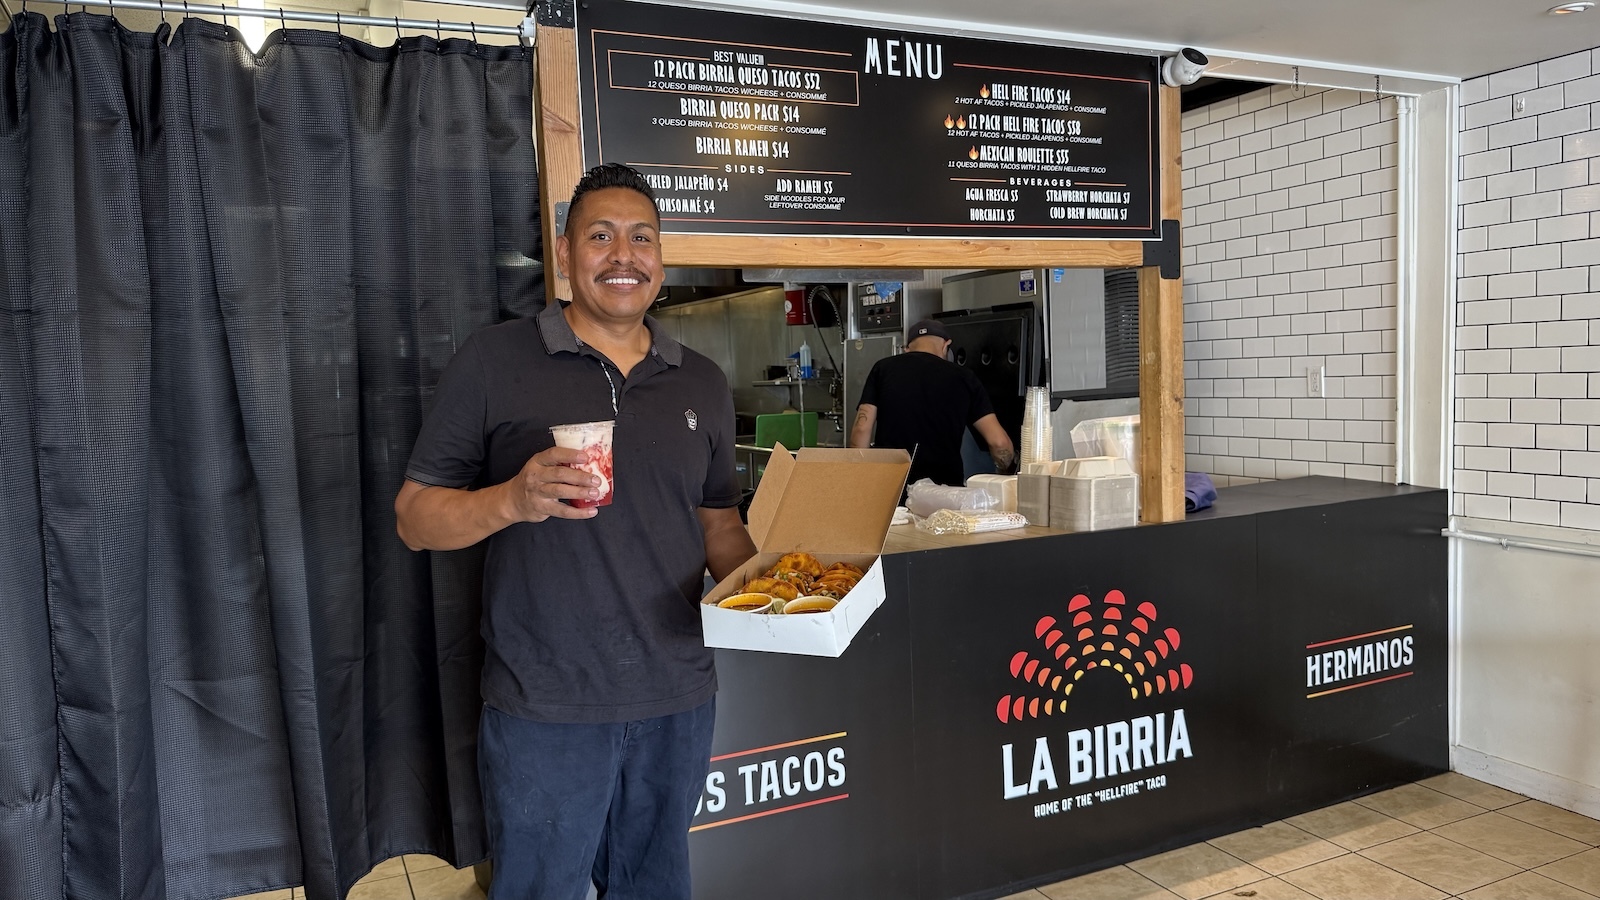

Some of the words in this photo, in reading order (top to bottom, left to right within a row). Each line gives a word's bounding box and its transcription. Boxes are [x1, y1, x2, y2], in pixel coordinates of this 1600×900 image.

[714, 51, 733, 62] BEST
[865, 38, 943, 79] MENU
[654, 60, 664, 77] 12
[668, 61, 695, 80] PACK
[699, 63, 734, 83] BIRRIA
[738, 66, 768, 86] QUESO
[772, 69, 801, 88] TACOS
[805, 72, 820, 90] $52
[658, 82, 686, 90] QUESO
[688, 84, 712, 92] BIRRIA
[741, 88, 778, 97] W/CHEESE
[786, 92, 827, 100] CONSOMMÉ
[992, 84, 1009, 100] HELL
[1012, 85, 1028, 101] FIRE
[1031, 87, 1054, 103] TACOS
[1057, 89, 1071, 104] $14
[680, 98, 716, 117] BIRRIA
[720, 101, 750, 119] QUESO
[754, 103, 779, 121] PACK
[783, 105, 799, 123] $14
[658, 118, 686, 126] QUESO
[741, 124, 778, 132] W/CHEESE
[785, 126, 826, 135] CONSOMMÉ
[969, 114, 977, 129] 12
[980, 114, 1000, 130] PACK
[1003, 116, 1020, 132] HELL
[1023, 117, 1039, 133] FIRE
[1041, 118, 1065, 134] TACOS
[1068, 120, 1080, 136] $58
[696, 137, 731, 155] BIRRIA
[735, 139, 768, 157] RAMEN
[772, 141, 789, 158] $14
[980, 145, 1014, 162] MEXICAN
[1017, 147, 1054, 163] ROULETTE
[725, 164, 764, 174] SIDES
[636, 174, 671, 189] CKLED
[675, 174, 714, 191] JALAPEÑO
[717, 178, 728, 192] $4
[776, 179, 792, 192] ADD
[795, 180, 821, 193] RAMEN
[824, 181, 833, 194] $5
[1010, 178, 1071, 187] BEVERAGES
[966, 188, 984, 200] AGUA
[986, 189, 1008, 201] FRESCA
[1046, 190, 1088, 202] STRAWBERRY
[1090, 191, 1121, 203] HORCHATA
[1123, 192, 1130, 204] $7
[704, 200, 715, 214] $4
[970, 209, 1005, 221] HORCHATA
[1050, 207, 1065, 219] COLD
[1067, 207, 1085, 219] BREW
[1087, 208, 1118, 220] HORCHATA
[1121, 208, 1127, 220] $7
[1306, 636, 1413, 687] HERMANOS
[1002, 737, 1058, 800] LA
[1068, 709, 1193, 785] BIRRIA
[694, 771, 726, 816] S
[738, 747, 846, 806] TACOS
[1034, 800, 1059, 818] HOME
[1062, 798, 1074, 812] OF
[1076, 793, 1093, 808] THE
[1146, 775, 1166, 791] TACO
